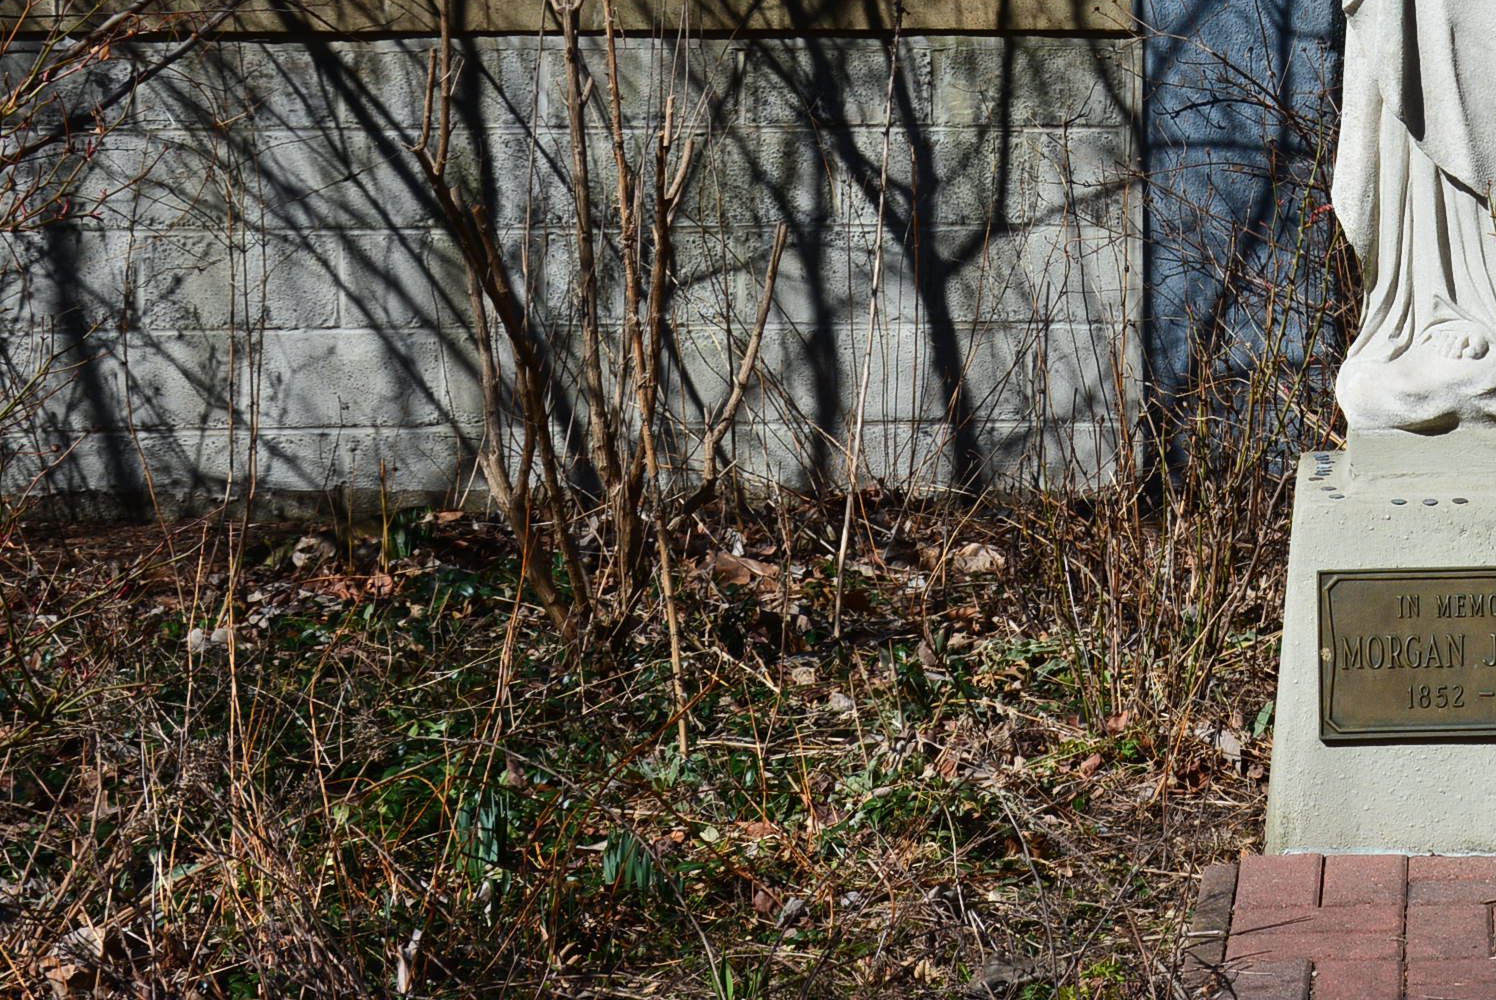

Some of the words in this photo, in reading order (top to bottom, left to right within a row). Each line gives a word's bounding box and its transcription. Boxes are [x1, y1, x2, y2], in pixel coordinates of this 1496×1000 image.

[1396, 594, 1420, 618] IN
[1340, 633, 1466, 670] MORGAN
[1407, 684, 1465, 709] 1852
